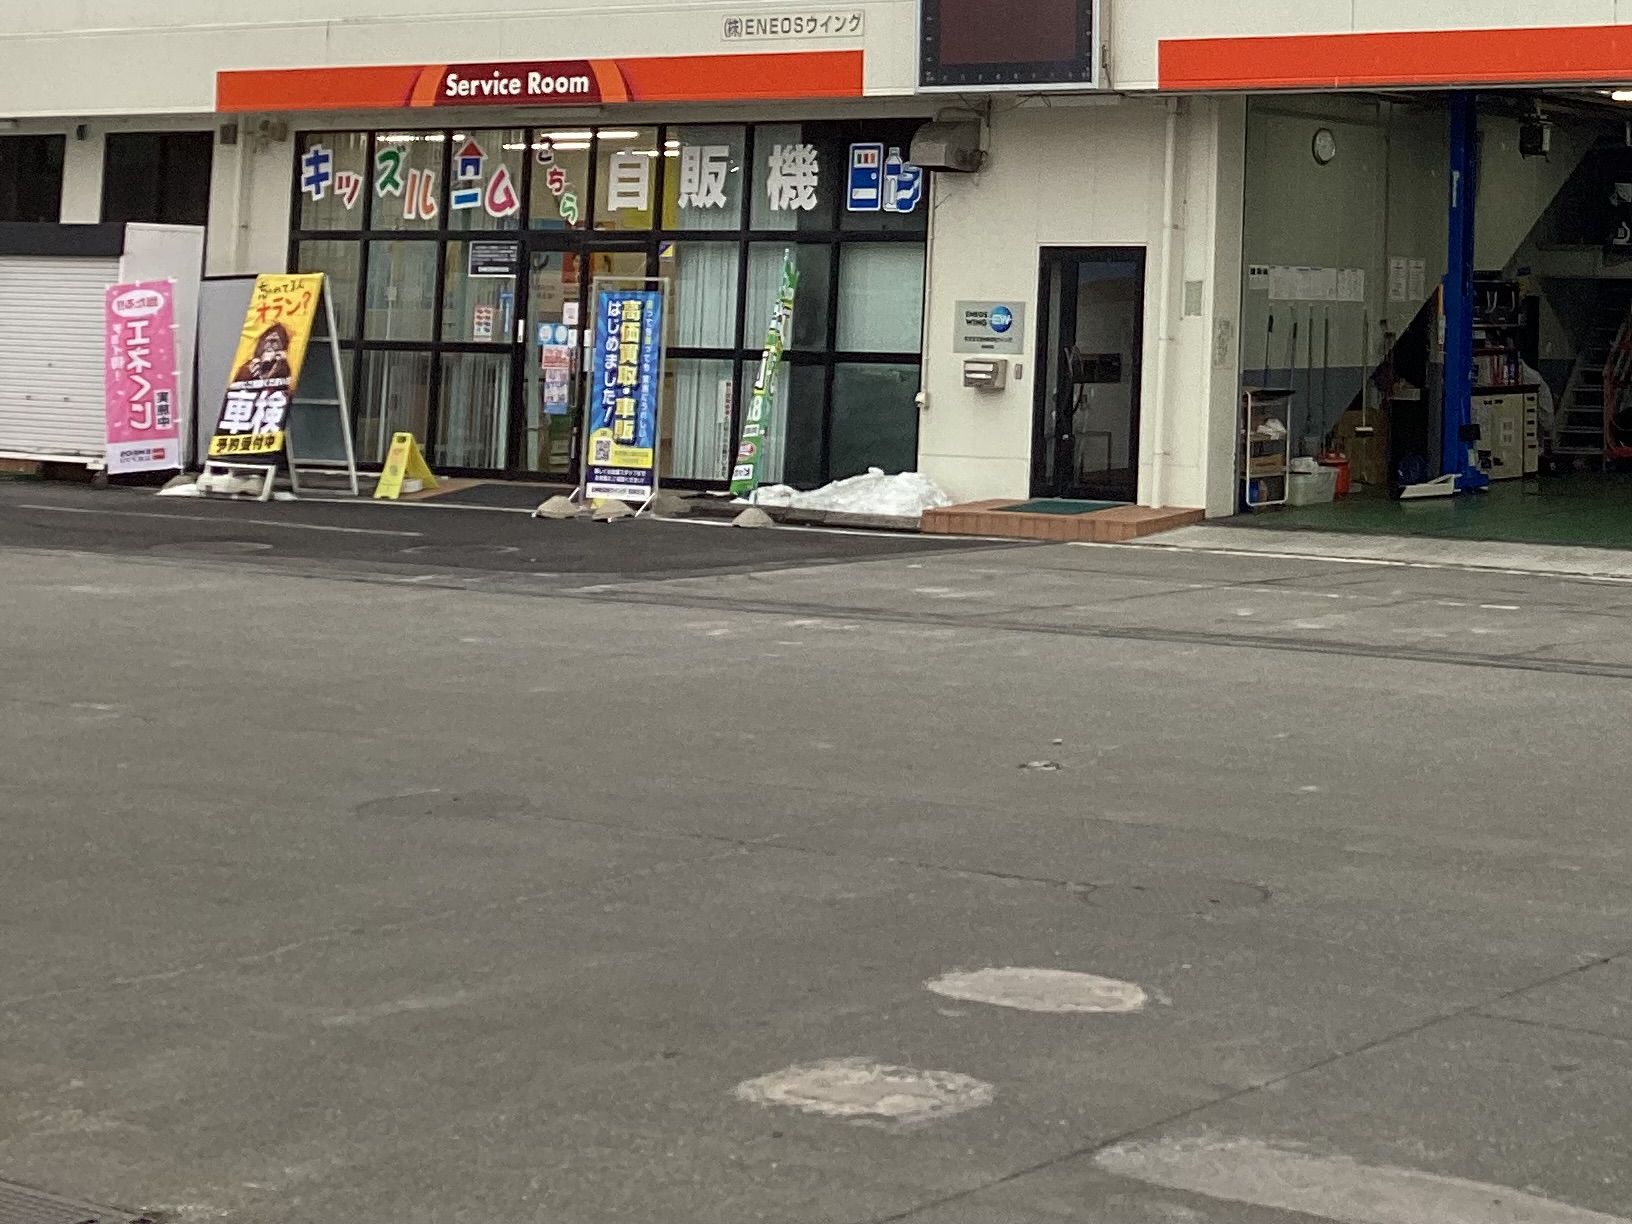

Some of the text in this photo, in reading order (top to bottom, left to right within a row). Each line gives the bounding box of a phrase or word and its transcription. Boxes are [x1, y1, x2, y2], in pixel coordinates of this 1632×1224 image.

[445, 71, 589, 97] Service Room
[607, 143, 818, 212] 自販機
[219, 389, 288, 435] 車検
